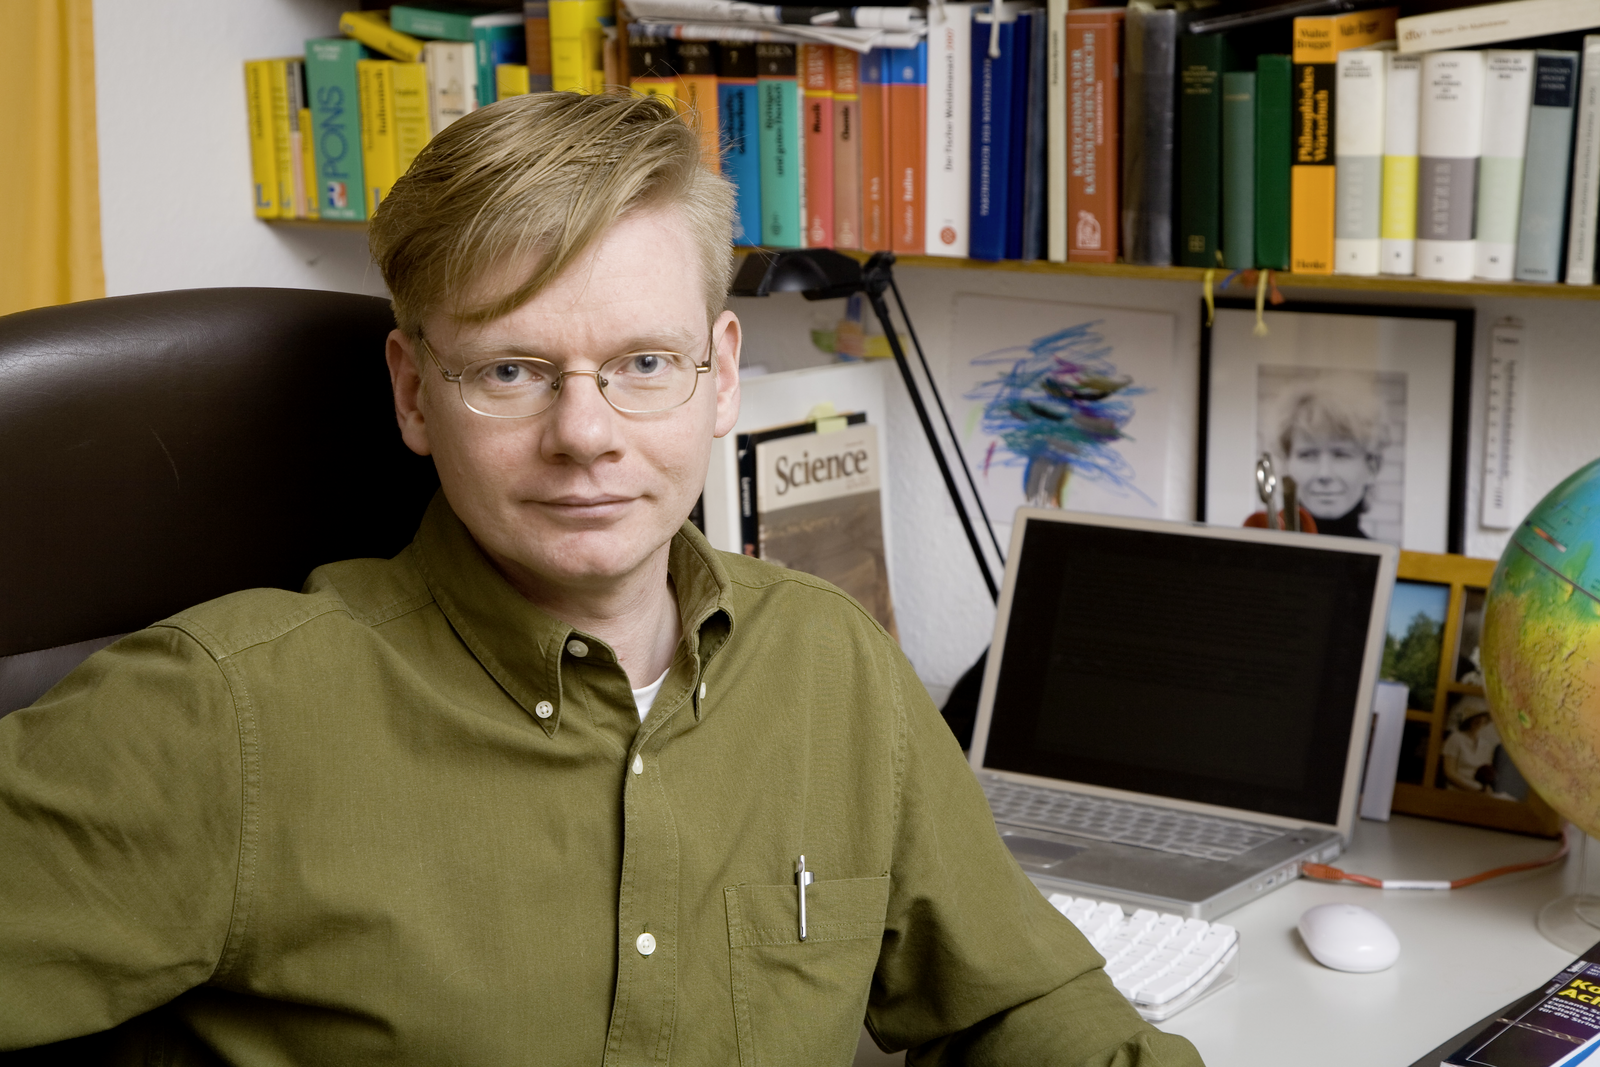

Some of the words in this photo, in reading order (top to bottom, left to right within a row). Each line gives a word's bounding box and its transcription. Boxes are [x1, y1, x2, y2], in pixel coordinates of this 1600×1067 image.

[946, 27, 955, 51] 2007
[1295, 38, 1332, 50] Brugger
[1299, 29, 1330, 39] Walter
[1071, 49, 1083, 78] DER
[1084, 30, 1096, 84] KIRCHE
[945, 53, 954, 119] Weltalmanach
[775, 83, 785, 124] Deutsch
[813, 103, 822, 133] Musik
[1299, 65, 1315, 162] Philosophisches
[317, 86, 349, 179] PONS
[945, 121, 953, 153] Fischer
[1071, 79, 1083, 177] KATECHISMUS
[1084, 86, 1096, 195] KATHOLISCHEN
[1314, 90, 1329, 162] Wörterbuch
[945, 156, 953, 172] Der
[903, 167, 913, 202] Italien
[1296, 259, 1327, 271] Herder
[775, 449, 868, 496] Science
[1547, 1000, 1594, 1018] Expansion
[1551, 997, 1589, 1010] Rasante
[1554, 1011, 1570, 1019] die
